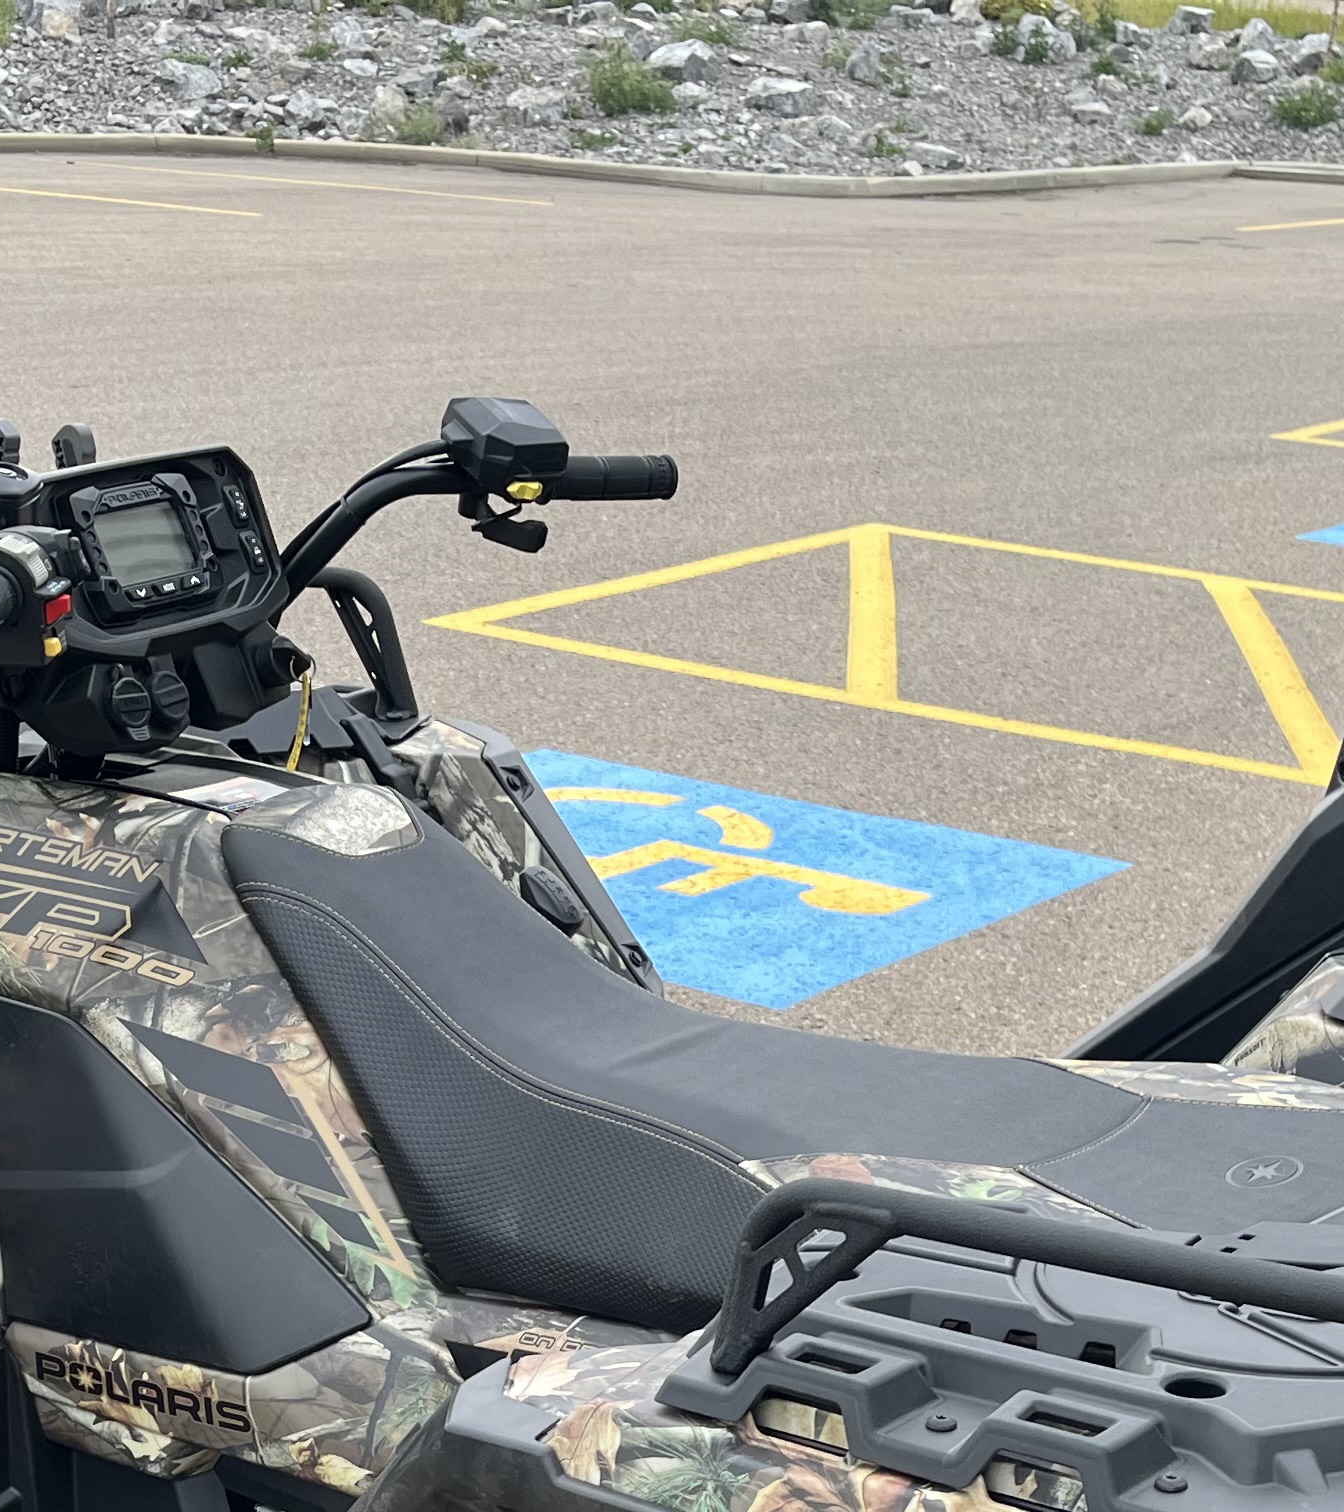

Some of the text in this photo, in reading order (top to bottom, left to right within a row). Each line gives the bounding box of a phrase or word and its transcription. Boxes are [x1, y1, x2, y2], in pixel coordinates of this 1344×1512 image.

[108, 487, 158, 507] POLARIS
[29, 928, 197, 987] 1000
[35, 1351, 252, 1434] POLARIS
